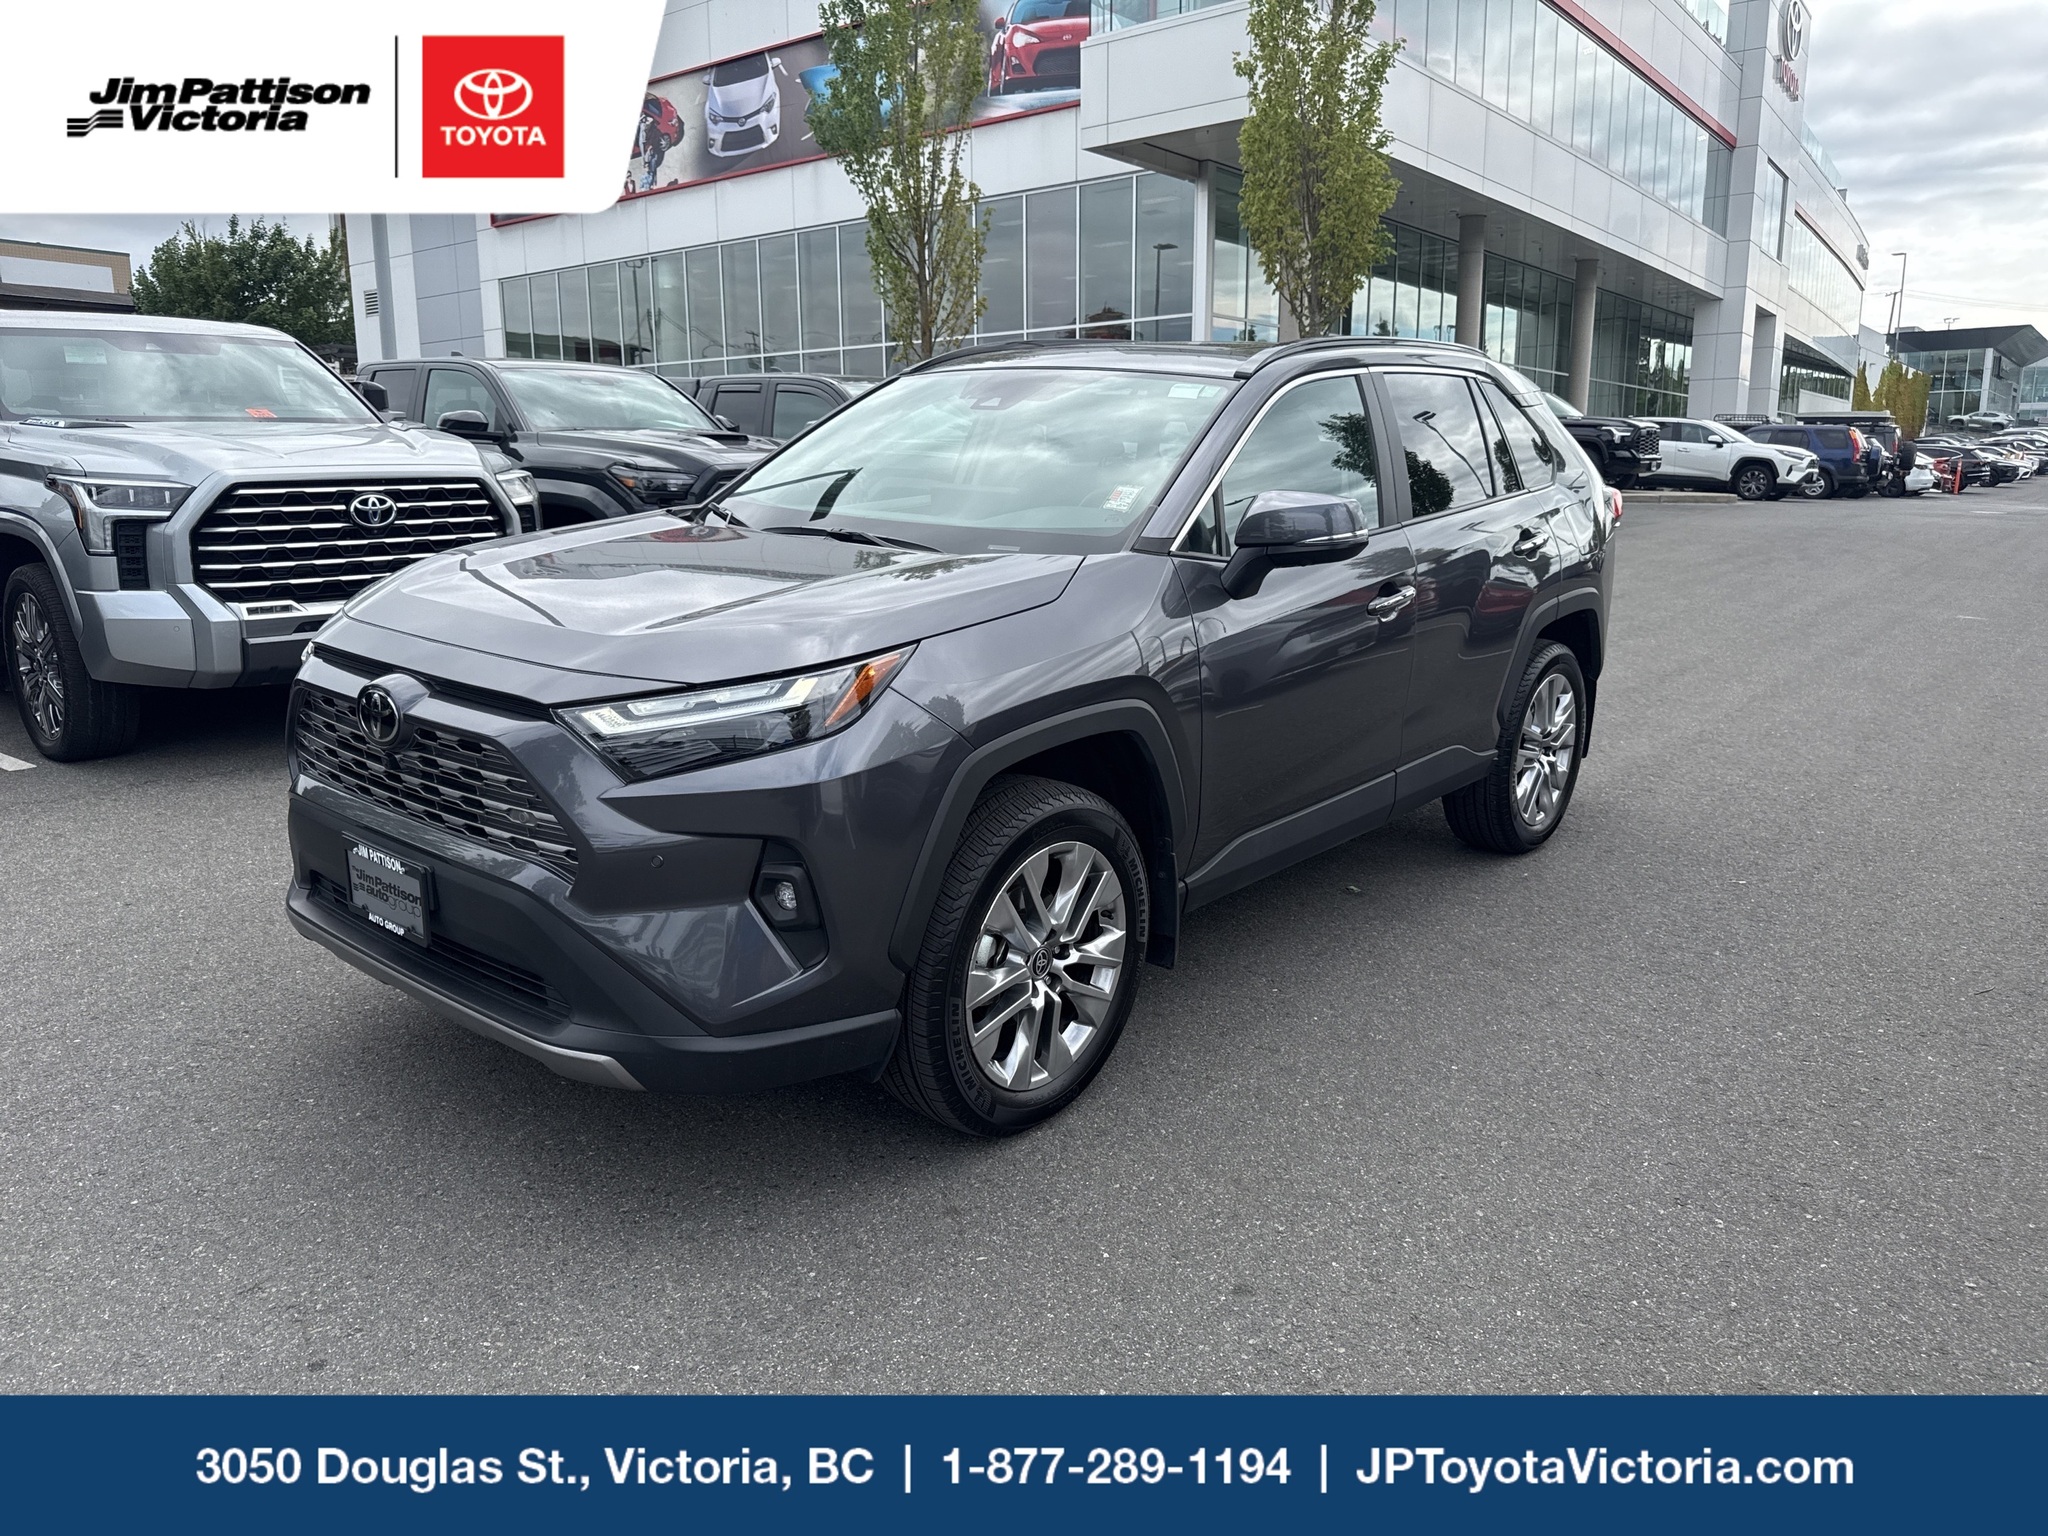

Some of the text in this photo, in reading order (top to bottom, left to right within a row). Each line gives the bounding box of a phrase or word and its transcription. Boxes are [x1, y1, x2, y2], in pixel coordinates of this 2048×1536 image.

[358, 844, 401, 872] JIM PATTISON
[368, 912, 405, 936] AUTO GROUP
[1128, 856, 1148, 939] MICHELIN
[952, 1003, 977, 1090] MICHELIN
